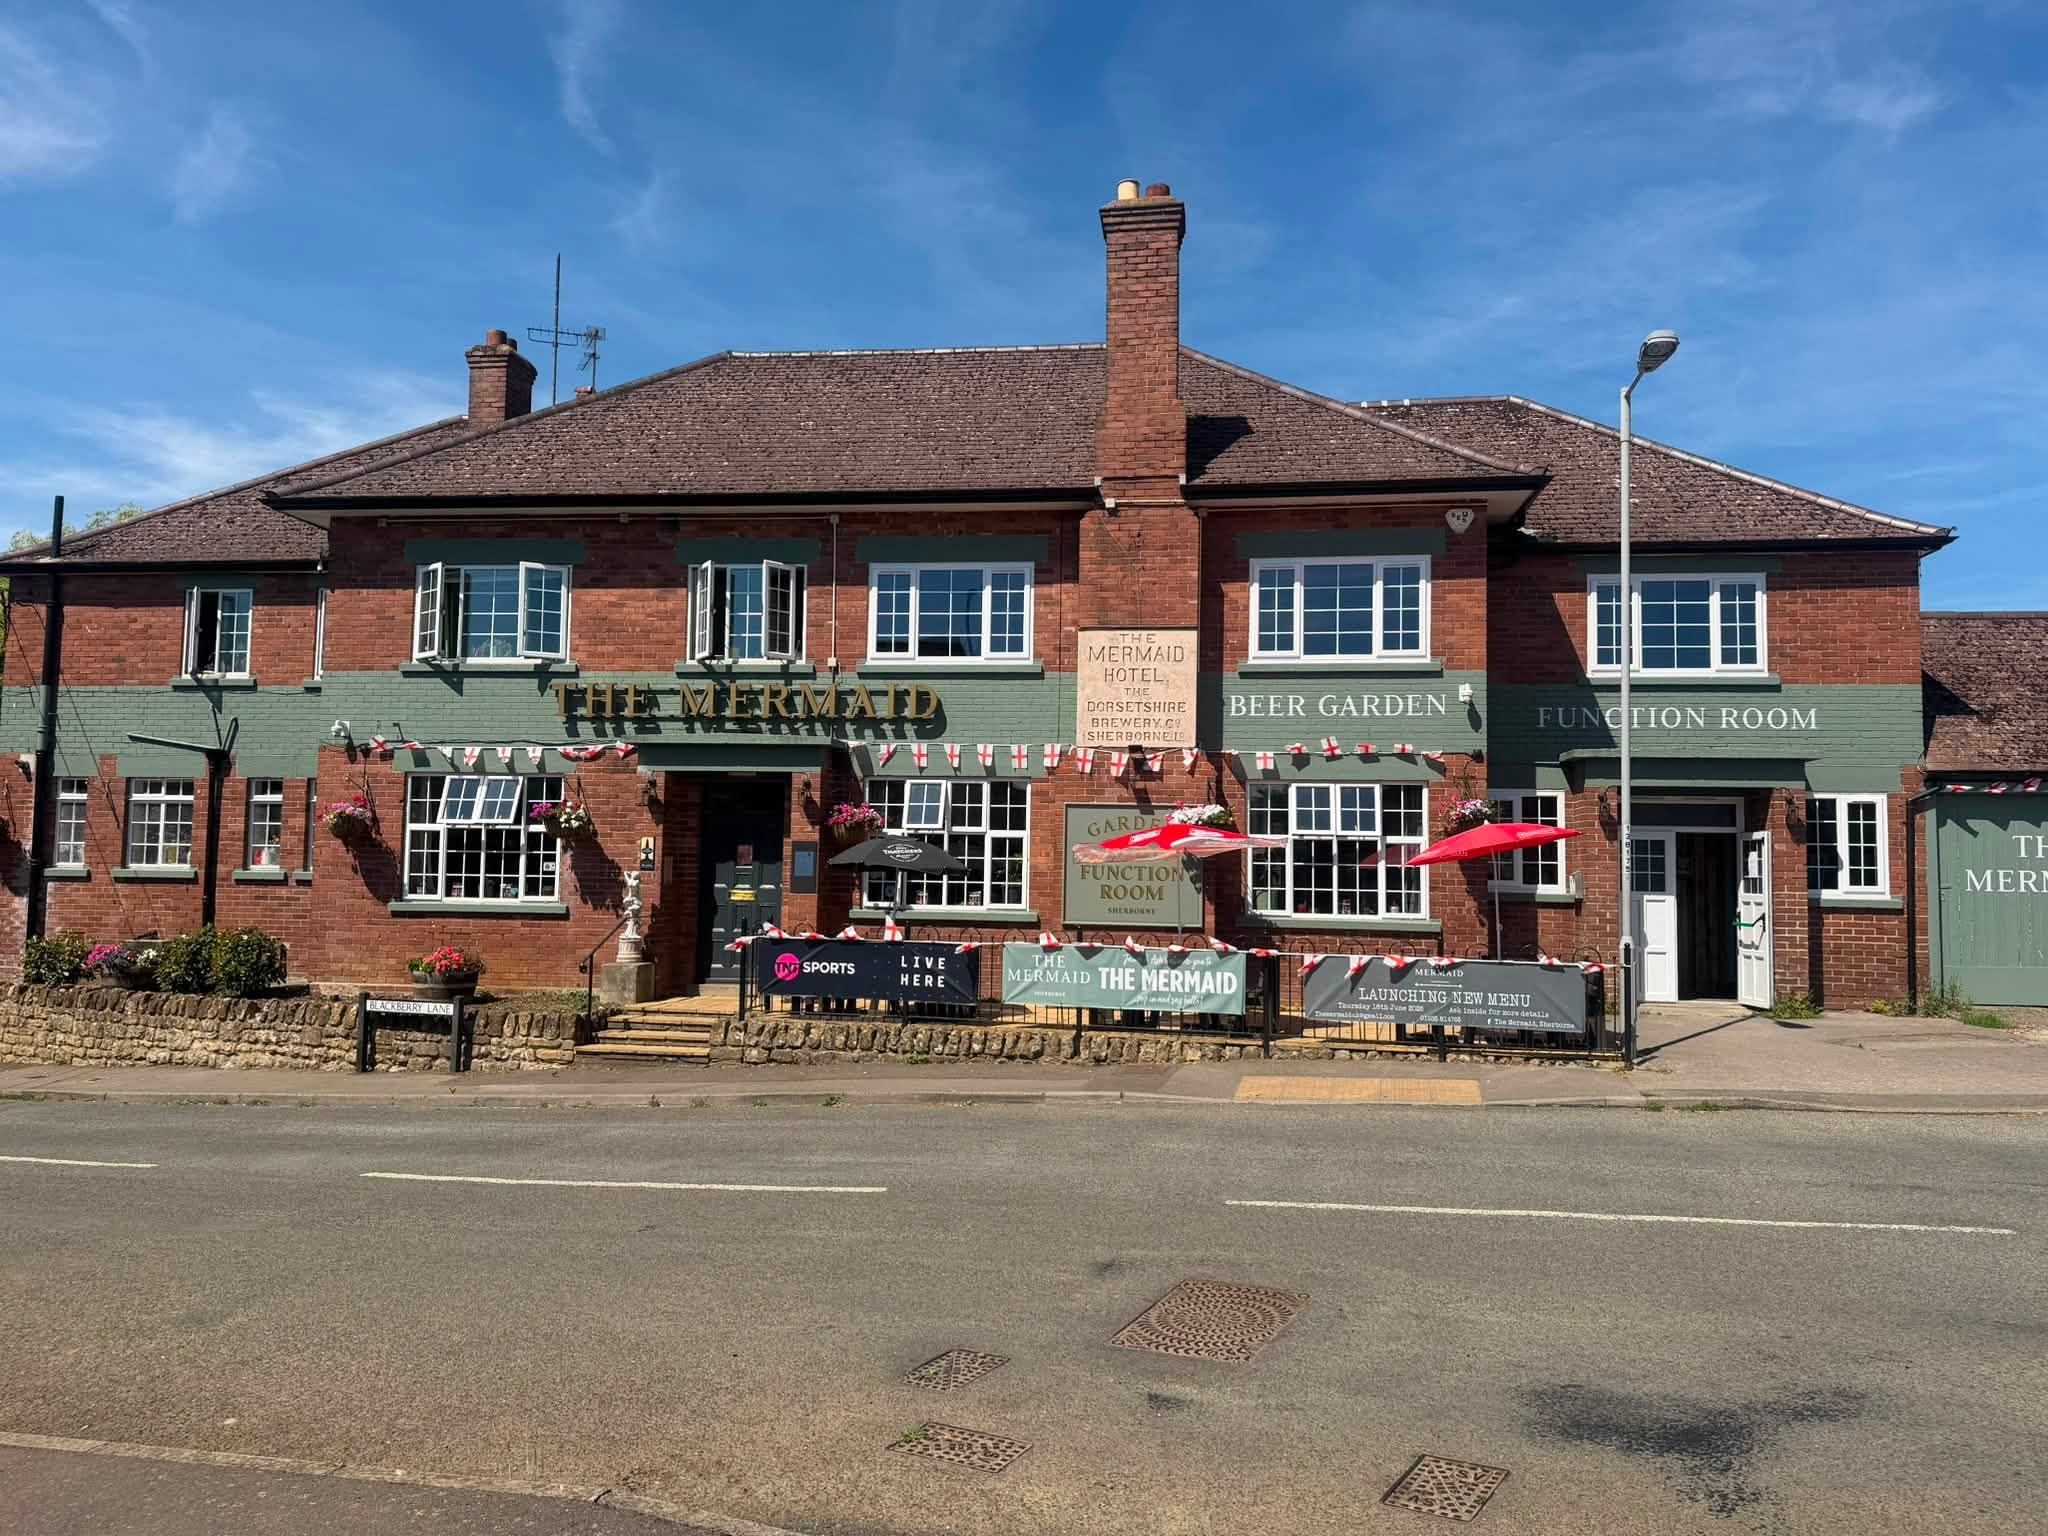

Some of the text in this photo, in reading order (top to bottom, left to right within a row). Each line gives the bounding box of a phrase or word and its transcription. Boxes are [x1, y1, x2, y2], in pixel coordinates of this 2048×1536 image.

[1120, 633, 1156, 643] THE
[1088, 646, 1185, 662] MERMAID
[1124, 687, 1150, 696] THE
[550, 683, 942, 720] THE MERMAID
[1087, 701, 1187, 713] DORSETSHIRE
[1230, 693, 1447, 717] BEER GARDEN
[1536, 707, 1818, 730] FUNCTION ROOM
[1087, 816, 1168, 837] GARDE
[1080, 864, 1185, 883] FUNCTION
[1100, 884, 1165, 901] ROOM
[1107, 907, 1156, 916] SHERBORNE
[802, 961, 856, 975] SPORTS
[900, 955, 946, 970] LIVE
[1031, 954, 1066, 968] THE
[1007, 968, 1091, 984] MERMAID
[1415, 968, 1464, 977] MERMAID
[900, 974, 946, 988] HERE
[1098, 967, 1238, 995] THE MERMAID
[1358, 987, 1531, 1008] LAUNCHING NEW MENU
[369, 1001, 451, 1014] BLACKBERRY LANE
[1338, 1001, 1370, 1011] Thursday
[1389, 1003, 1407, 1011] June
[1463, 1007, 1487, 1015] inside
[1488, 1008, 1501, 1016] for
[1502, 1009, 1519, 1017] more
[1520, 1009, 1549, 1018] details
[1495, 1018, 1507, 1026] The
